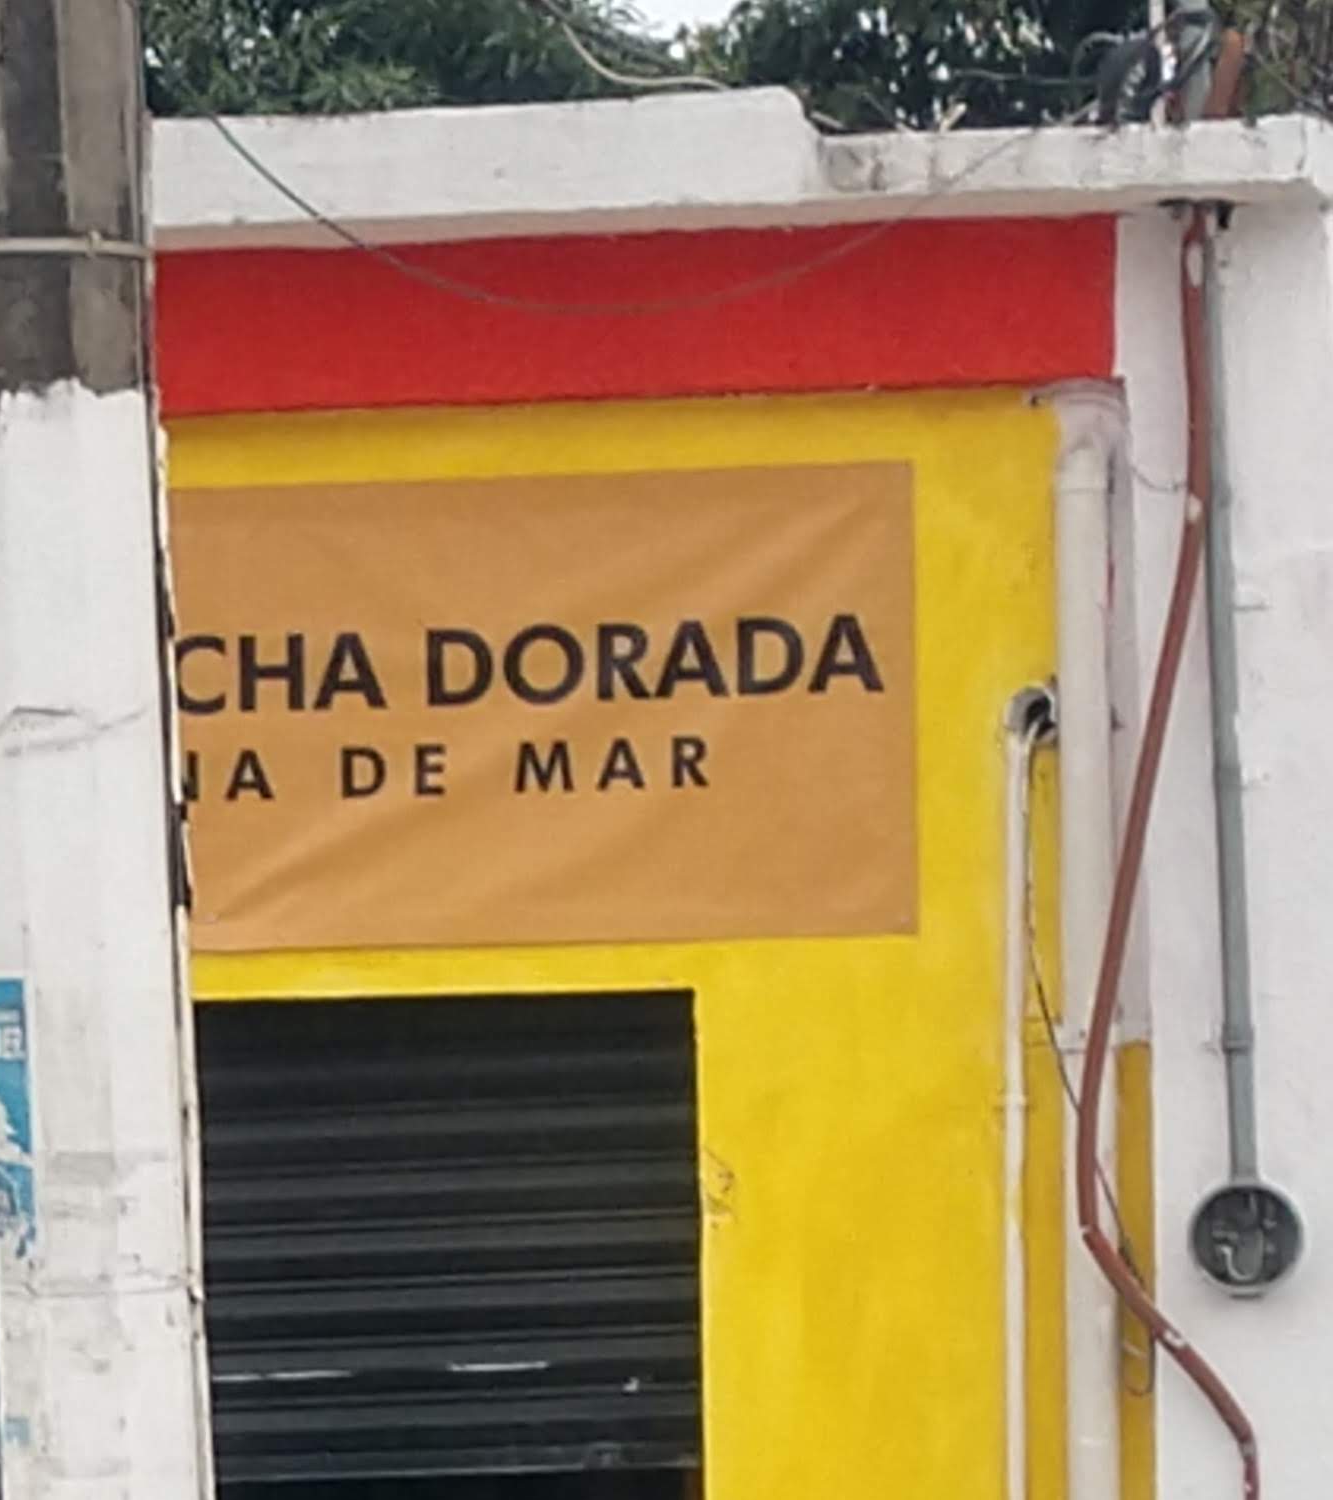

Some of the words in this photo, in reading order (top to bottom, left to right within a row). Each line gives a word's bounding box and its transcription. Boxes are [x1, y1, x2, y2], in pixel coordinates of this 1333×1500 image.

[425, 614, 884, 707] DORADA
[341, 744, 445, 799] DE
[514, 736, 708, 795] MAR
